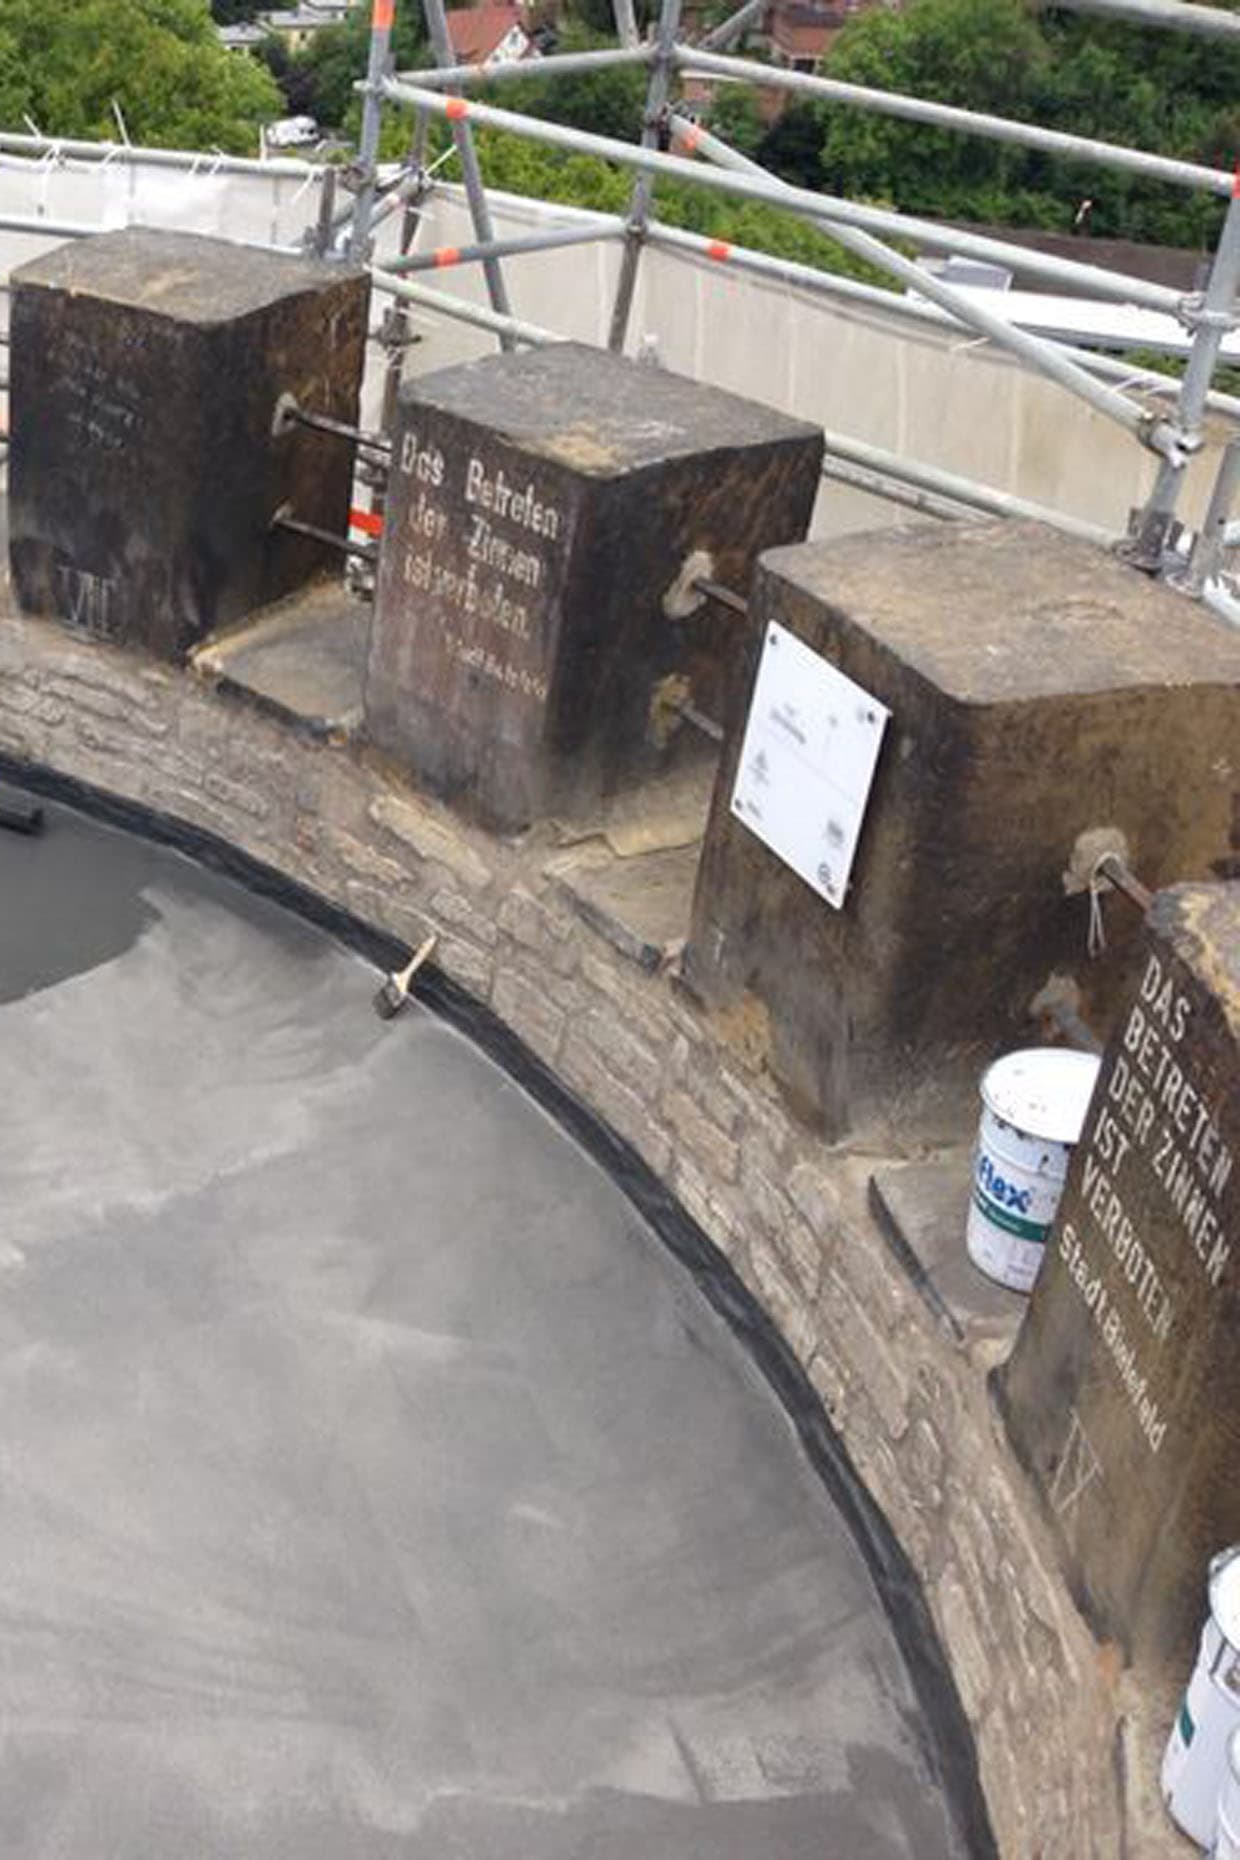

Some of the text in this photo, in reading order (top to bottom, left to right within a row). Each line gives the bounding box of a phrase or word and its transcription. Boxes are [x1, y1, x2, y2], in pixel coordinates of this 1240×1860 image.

[400, 431, 559, 540] Das Betreten
[1140, 953, 1191, 1042] DAS
[1093, 1106, 1131, 1177] IST
[1123, 1004, 1233, 1198] BETRETEN
[1109, 1056, 1230, 1286] DER ZINNEN
[1059, 1222, 1107, 1324] Stadt
[1080, 1155, 1175, 1340] VERBOTEN
